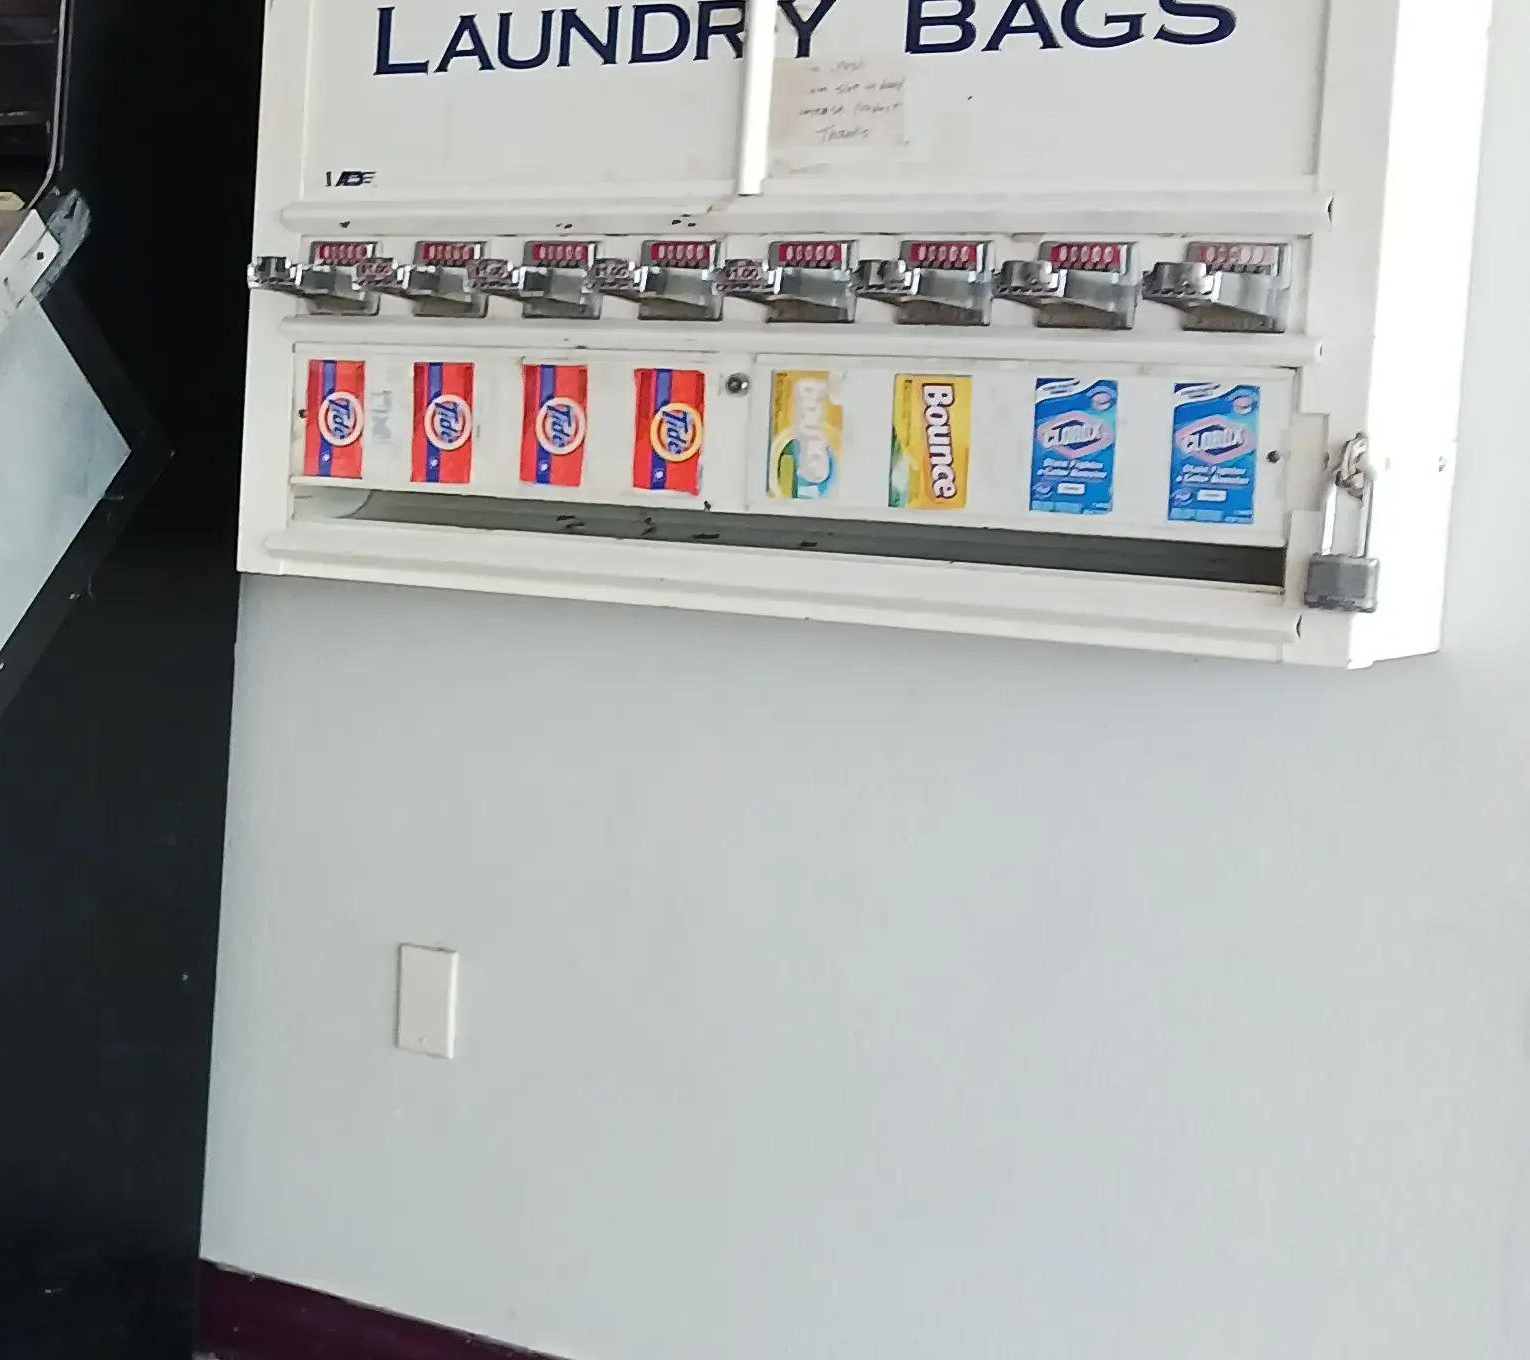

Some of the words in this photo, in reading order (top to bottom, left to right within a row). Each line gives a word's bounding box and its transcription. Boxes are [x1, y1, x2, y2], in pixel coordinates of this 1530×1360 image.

[546, 404, 572, 448] Tide
[661, 409, 688, 455] Tide
[921, 382, 958, 499] Bounce
